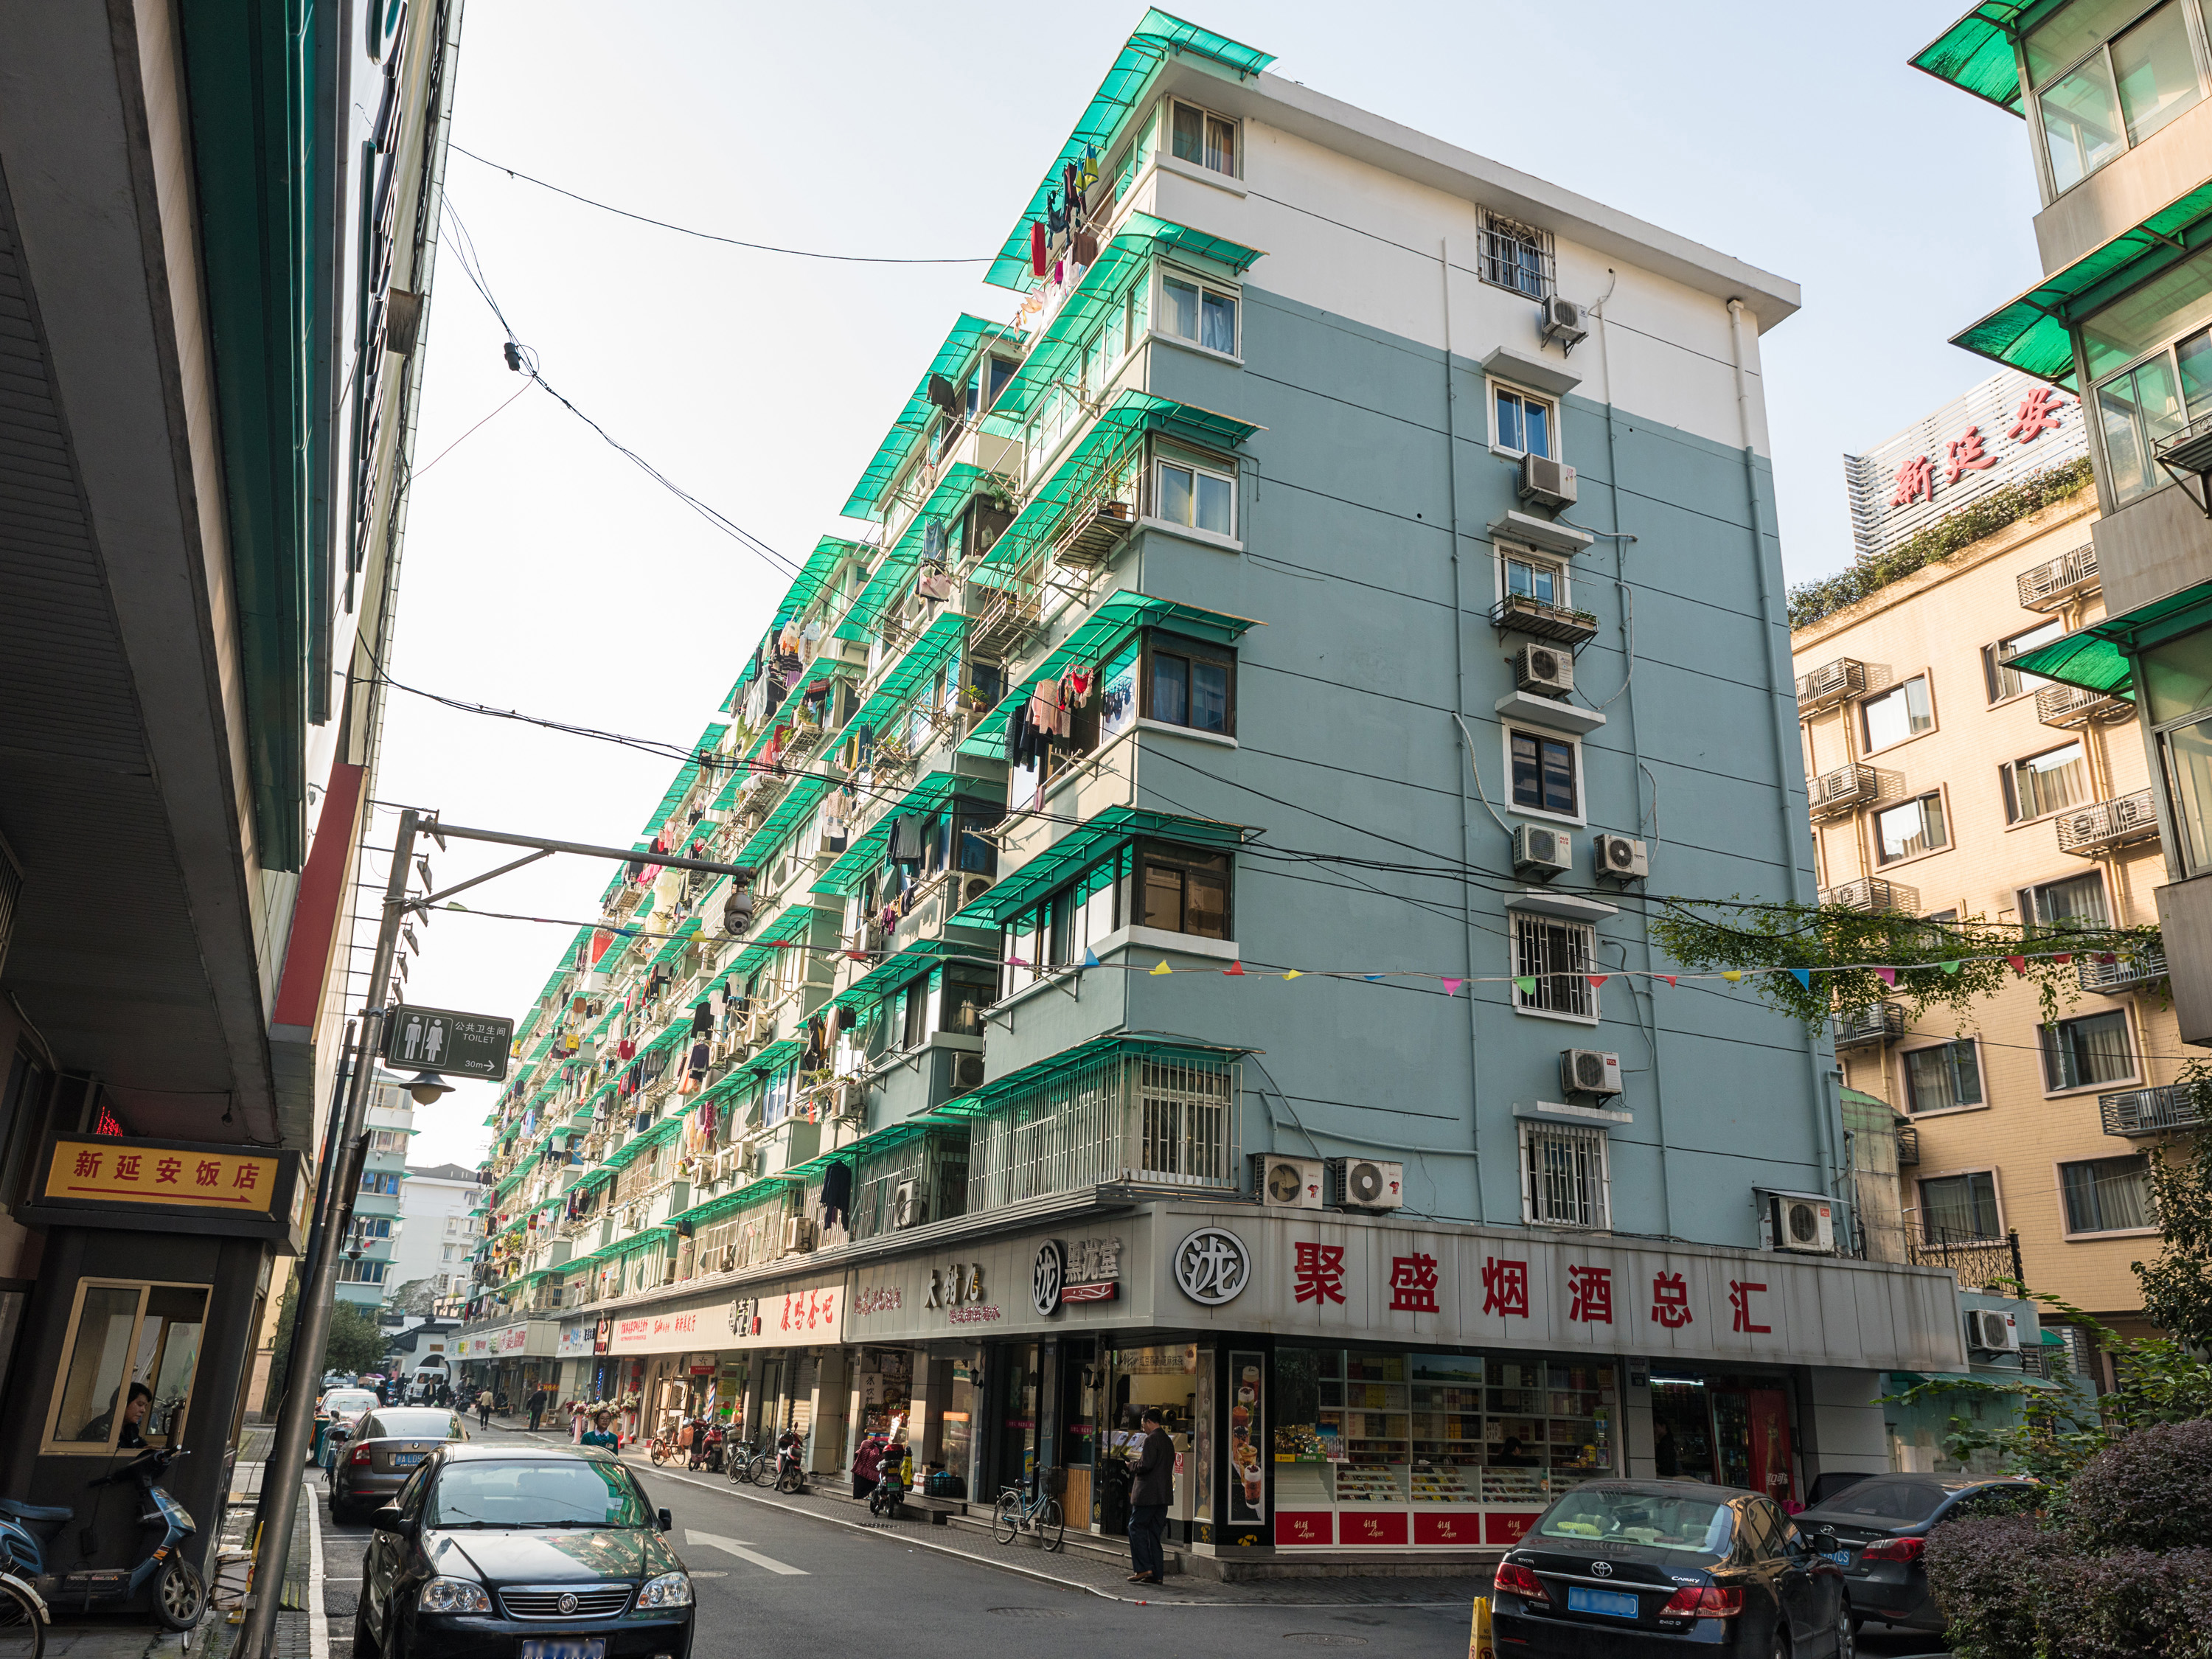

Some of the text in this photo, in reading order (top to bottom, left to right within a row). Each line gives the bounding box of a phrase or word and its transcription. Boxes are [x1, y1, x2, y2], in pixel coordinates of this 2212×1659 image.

[1890, 388, 2081, 507] 新延安
[455, 1020, 507, 1037] 公共卫生间
[463, 1032, 495, 1044] TOILET
[465, 1060, 483, 1068] 30m
[73, 1149, 261, 1190] 新延安饭店
[1295, 1242, 1773, 1335] 聚盛烟酒总汇
[1298, 1528, 1315, 1539] Liqun
[1367, 1527, 1384, 1538] Liqun
[1441, 1528, 1457, 1539] Liqun
[1671, 1576, 1700, 1584] CAMRY
